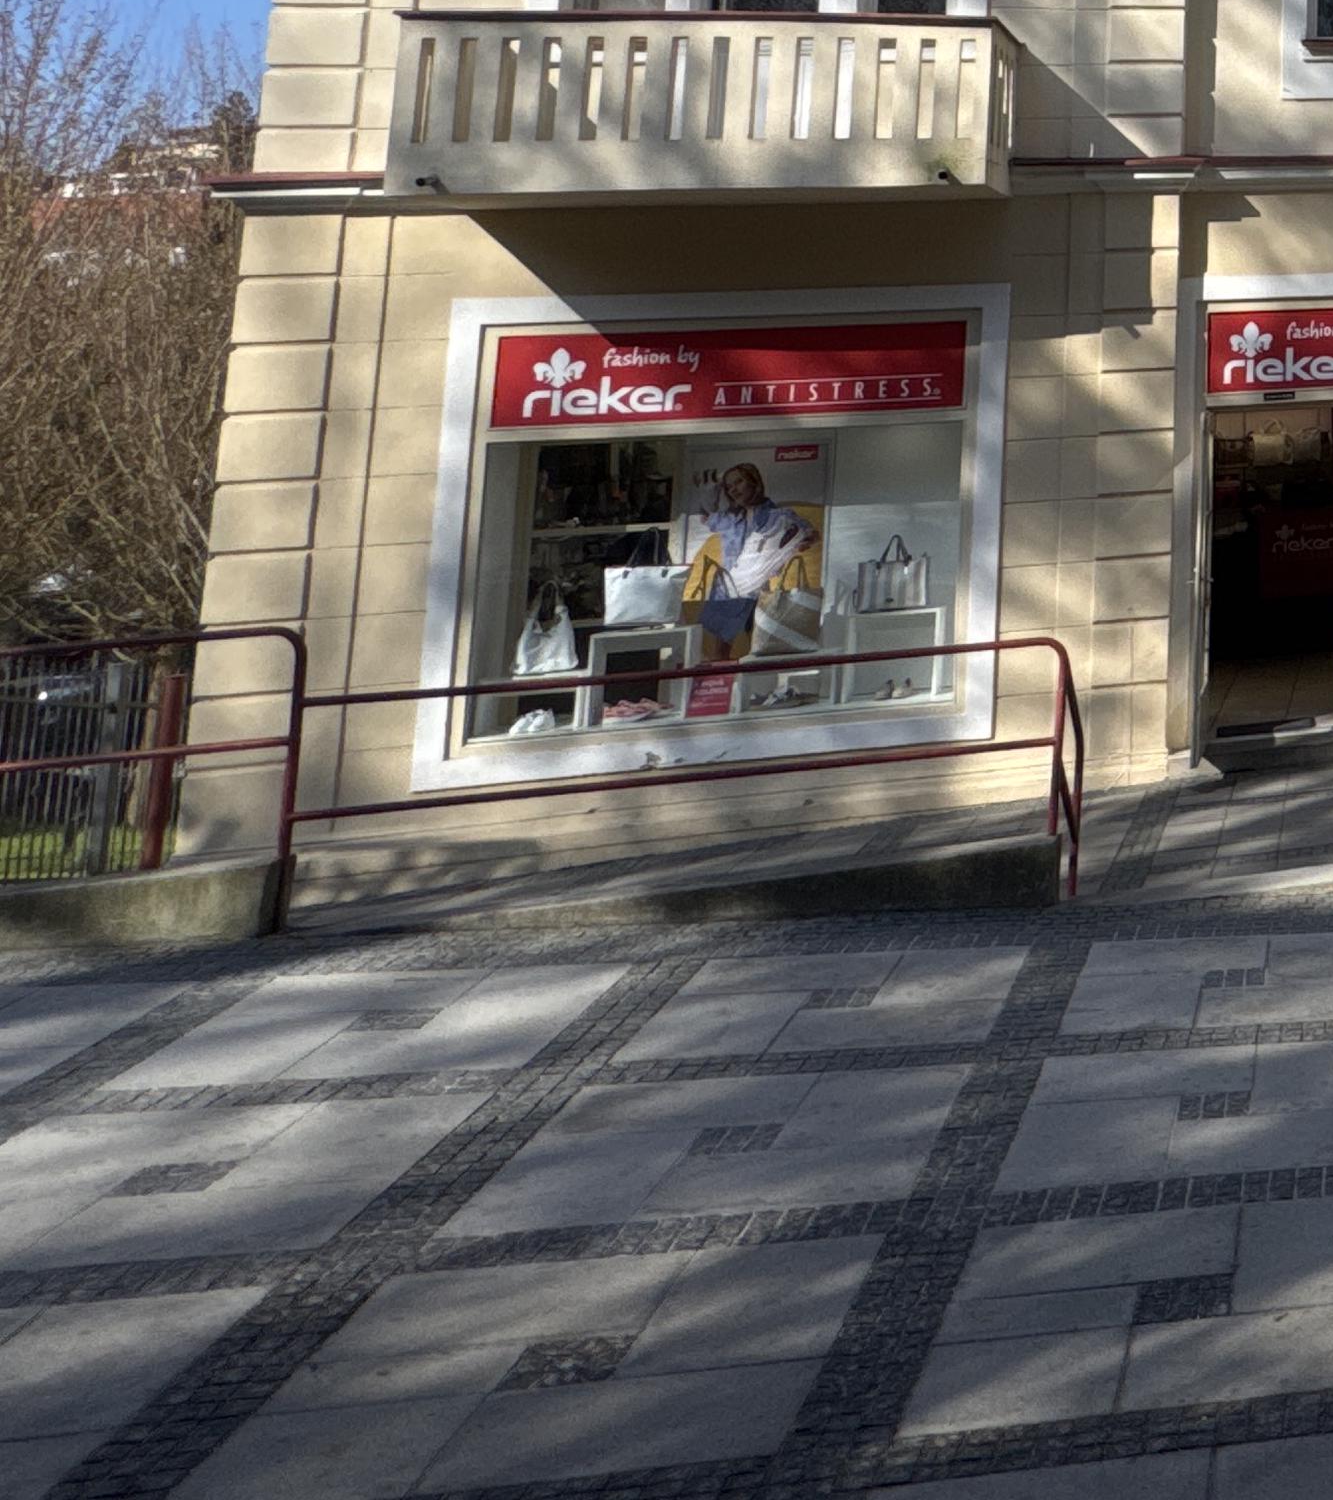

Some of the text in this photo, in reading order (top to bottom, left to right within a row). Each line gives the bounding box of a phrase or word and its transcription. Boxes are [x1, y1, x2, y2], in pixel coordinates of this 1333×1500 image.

[602, 344, 700, 372] fashion by
[521, 376, 934, 418] rieker ANTISTRESS
